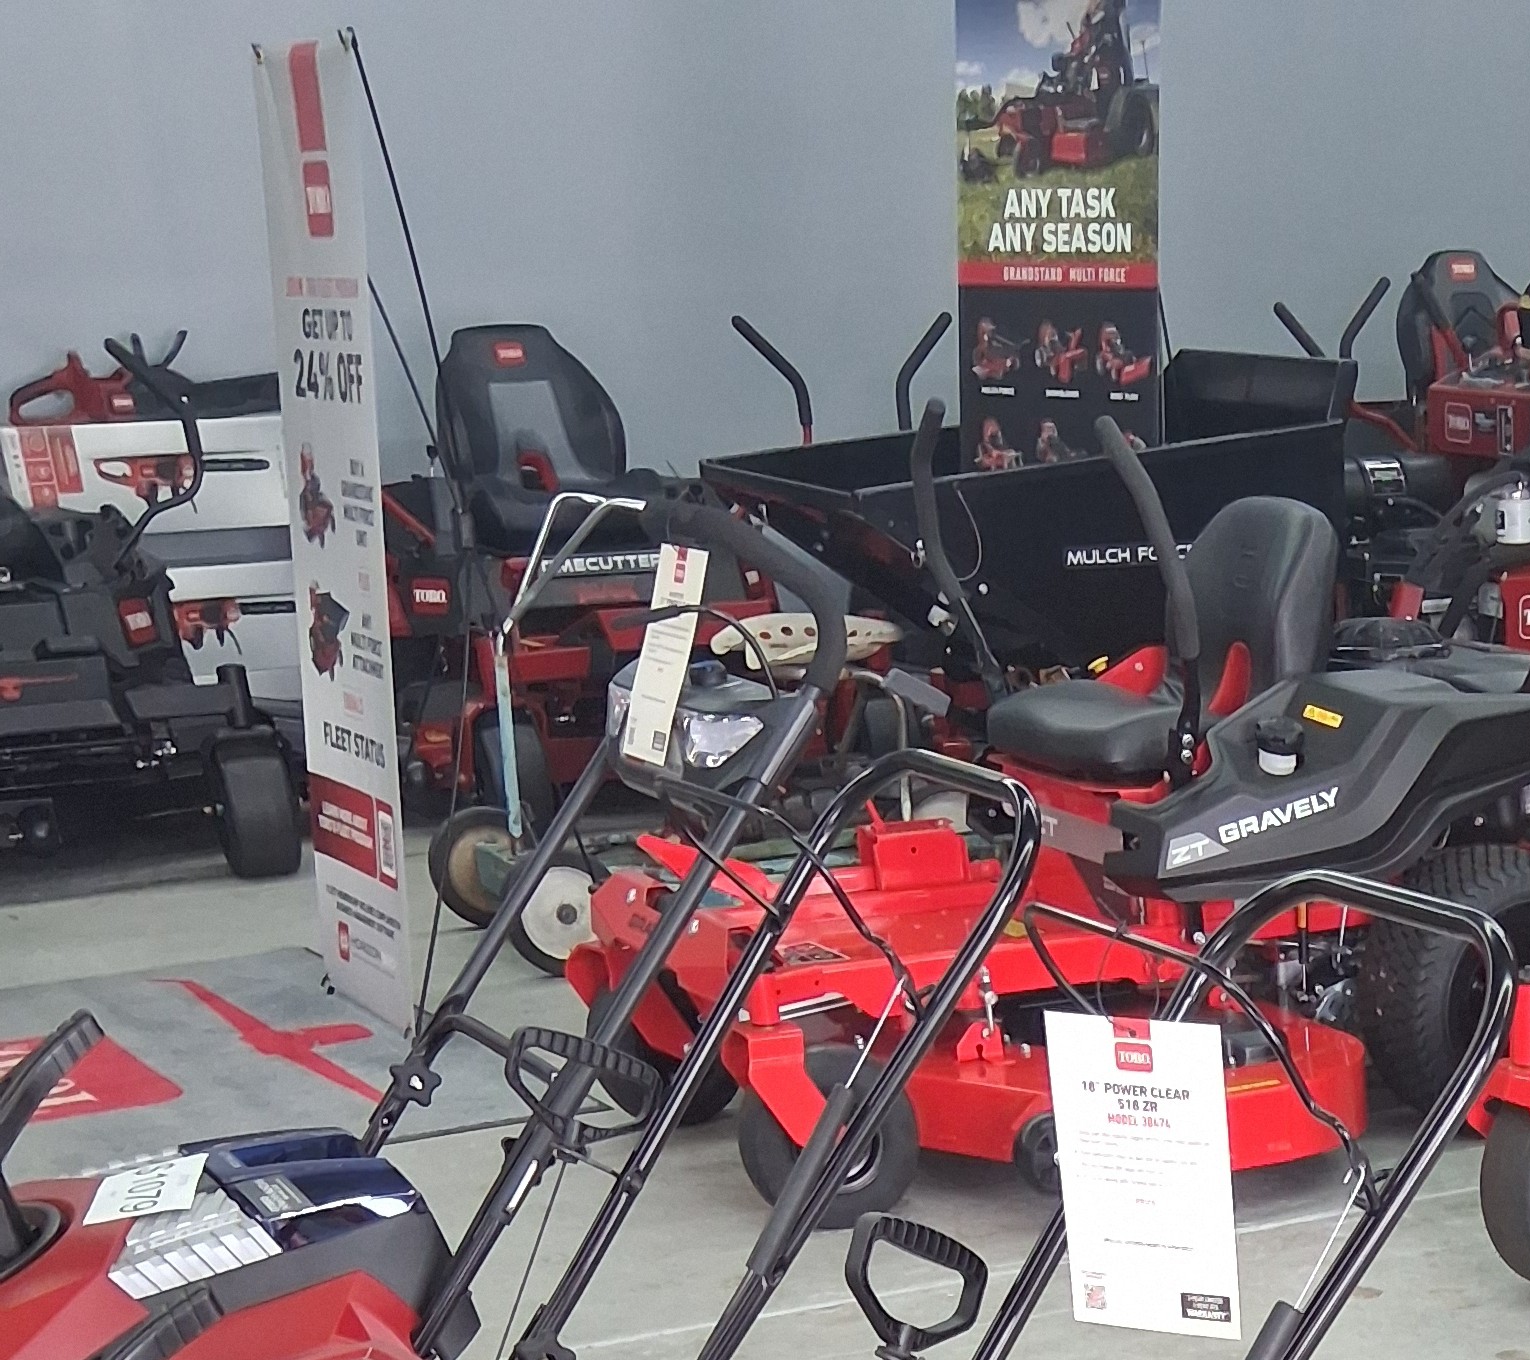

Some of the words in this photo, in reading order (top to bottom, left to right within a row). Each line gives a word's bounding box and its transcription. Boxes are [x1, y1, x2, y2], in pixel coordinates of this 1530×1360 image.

[1003, 188, 1052, 219] ANY
[1057, 187, 1116, 219] TASK
[988, 223, 1036, 253] ANY
[1042, 222, 1132, 253] SEASON
[1069, 267, 1096, 282] MULTI
[293, 348, 335, 401] 24%
[336, 351, 362, 403] OFF
[541, 553, 660, 573] TMECUTTER
[1066, 547, 1131, 566] MULCH
[413, 589, 447, 603] TORO
[323, 721, 353, 752] FLEET
[353, 733, 386, 769] STATUS
[1218, 786, 1340, 845] GRAVELY
[1171, 838, 1210, 866] ZT
[1117, 1051, 1150, 1065] TORO
[1104, 1083, 1147, 1098] POWER
[1150, 1087, 1190, 1101] CLEAR
[1142, 1101, 1158, 1113] ZR
